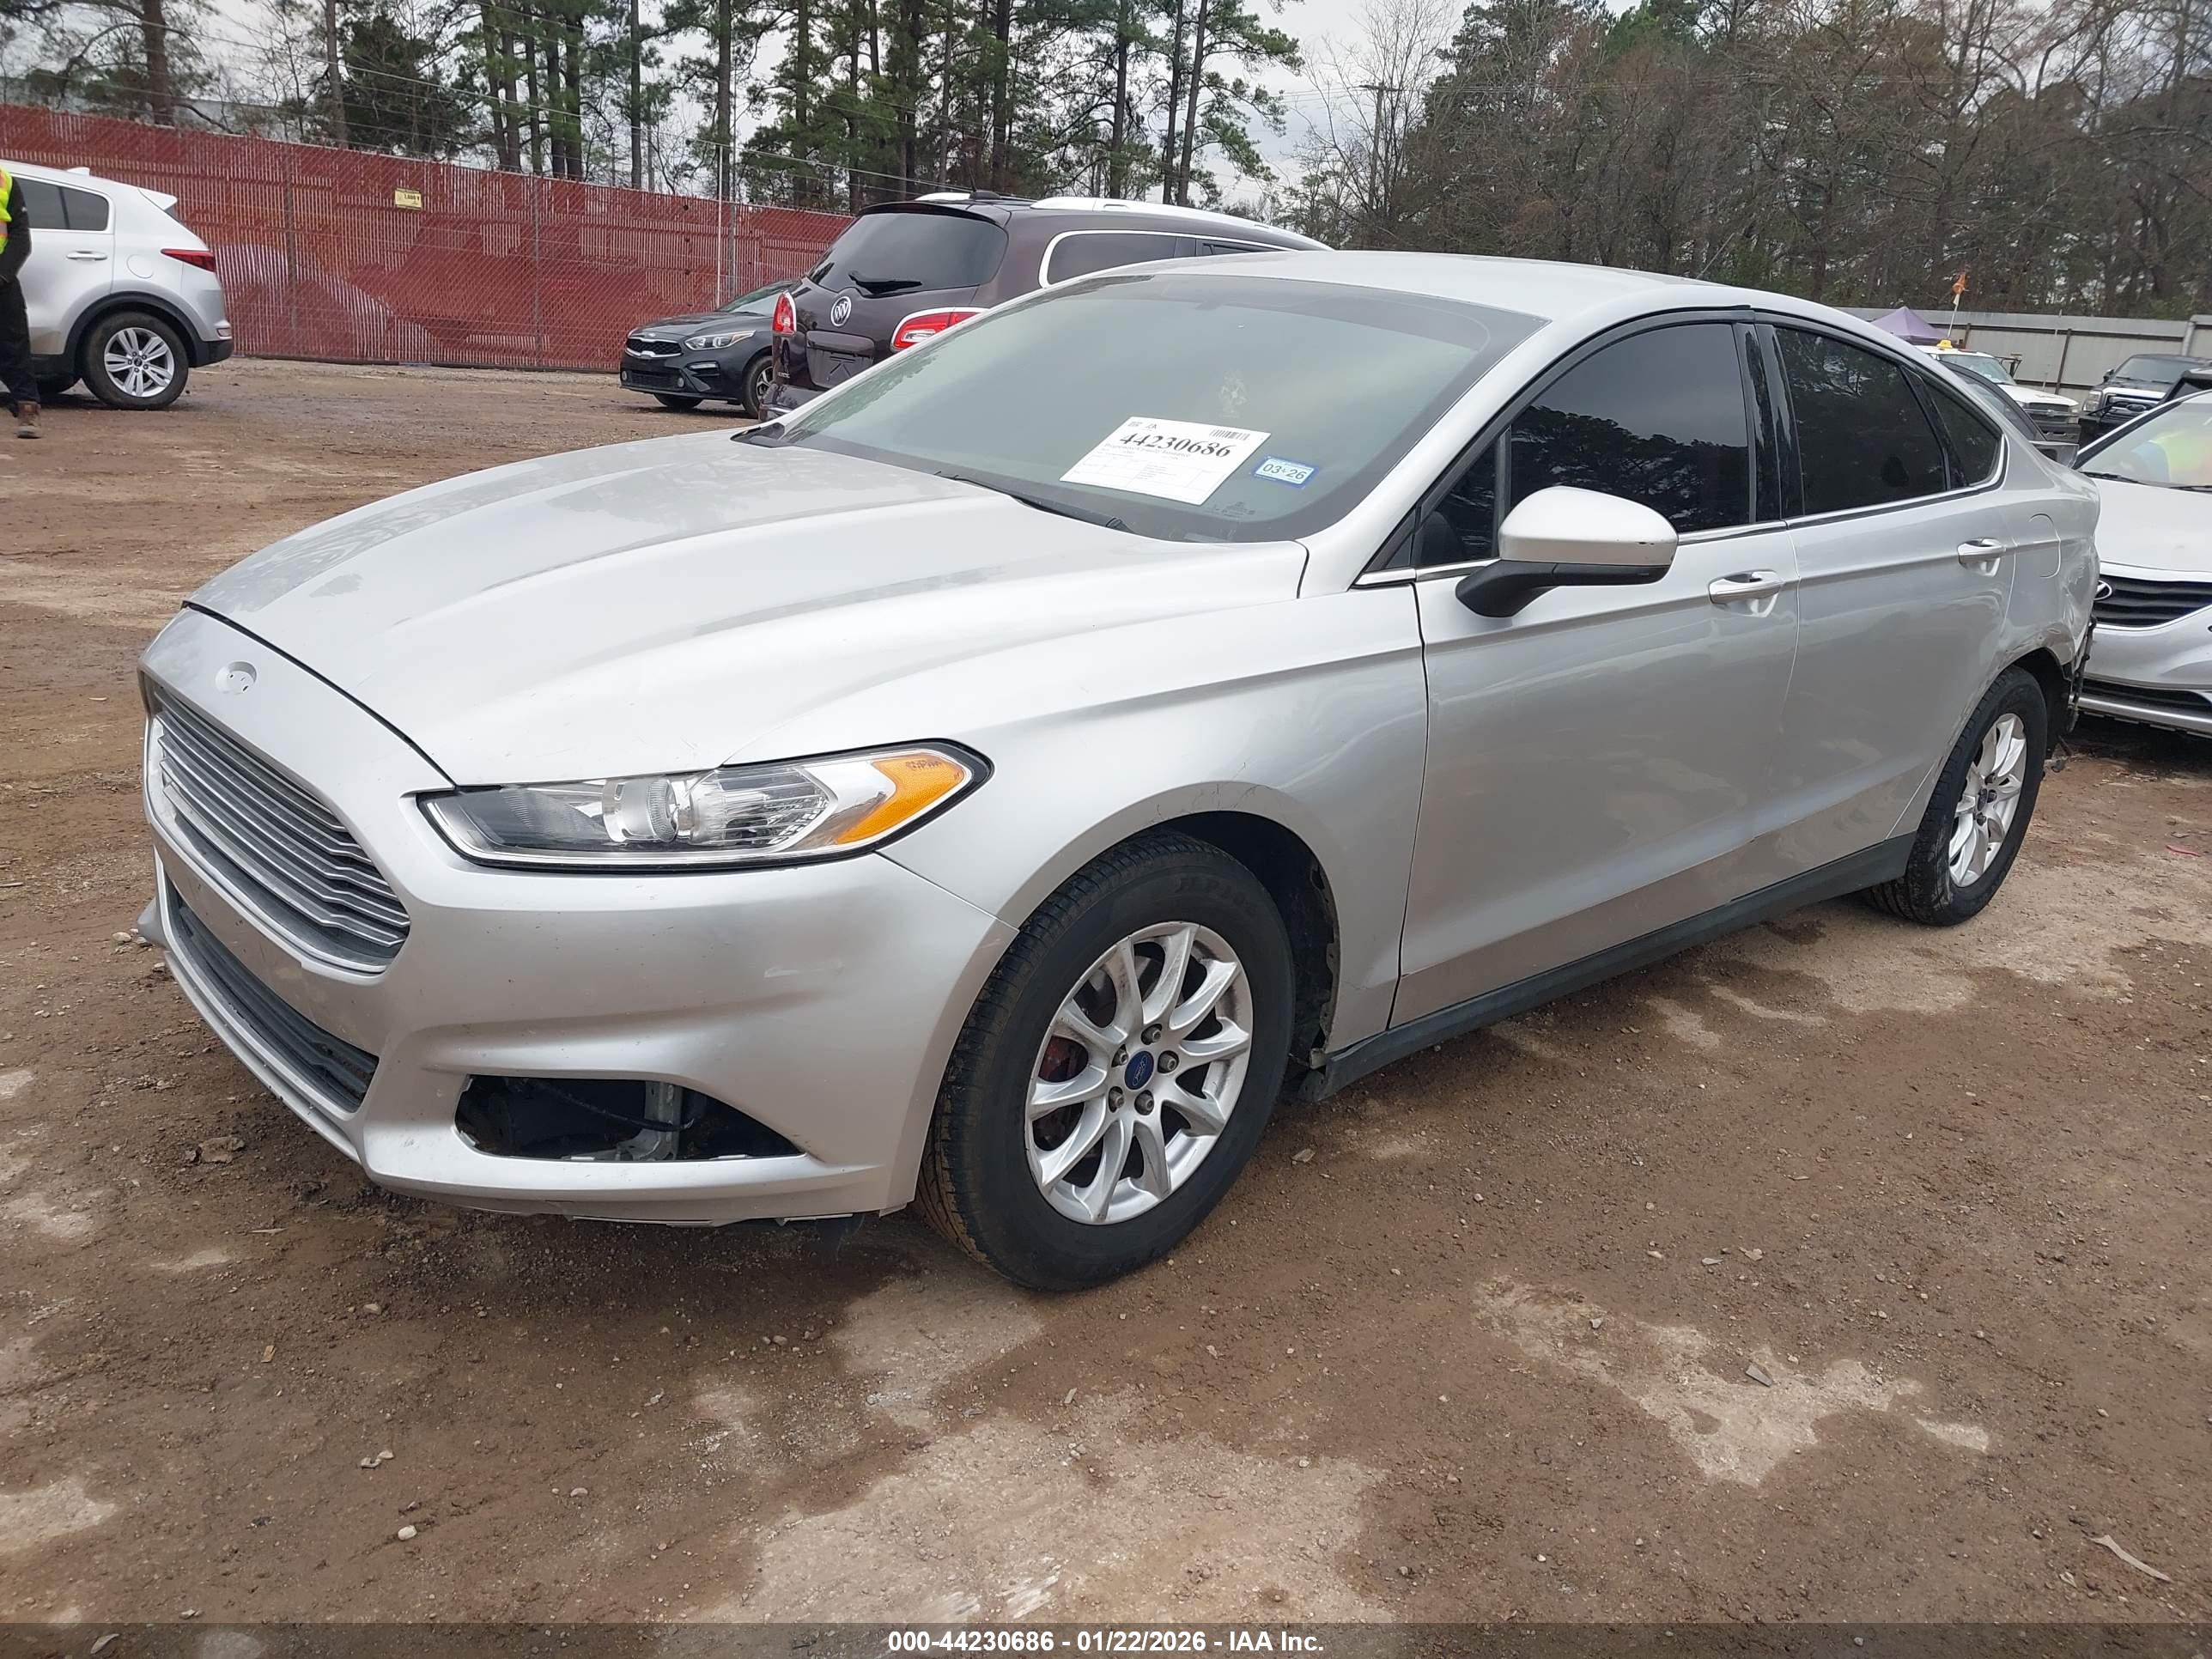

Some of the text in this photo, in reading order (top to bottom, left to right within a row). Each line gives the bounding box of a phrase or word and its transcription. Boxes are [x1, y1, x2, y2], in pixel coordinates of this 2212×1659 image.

[1119, 432, 1236, 457] 44230686
[1262, 463, 1307, 479] 03 26
